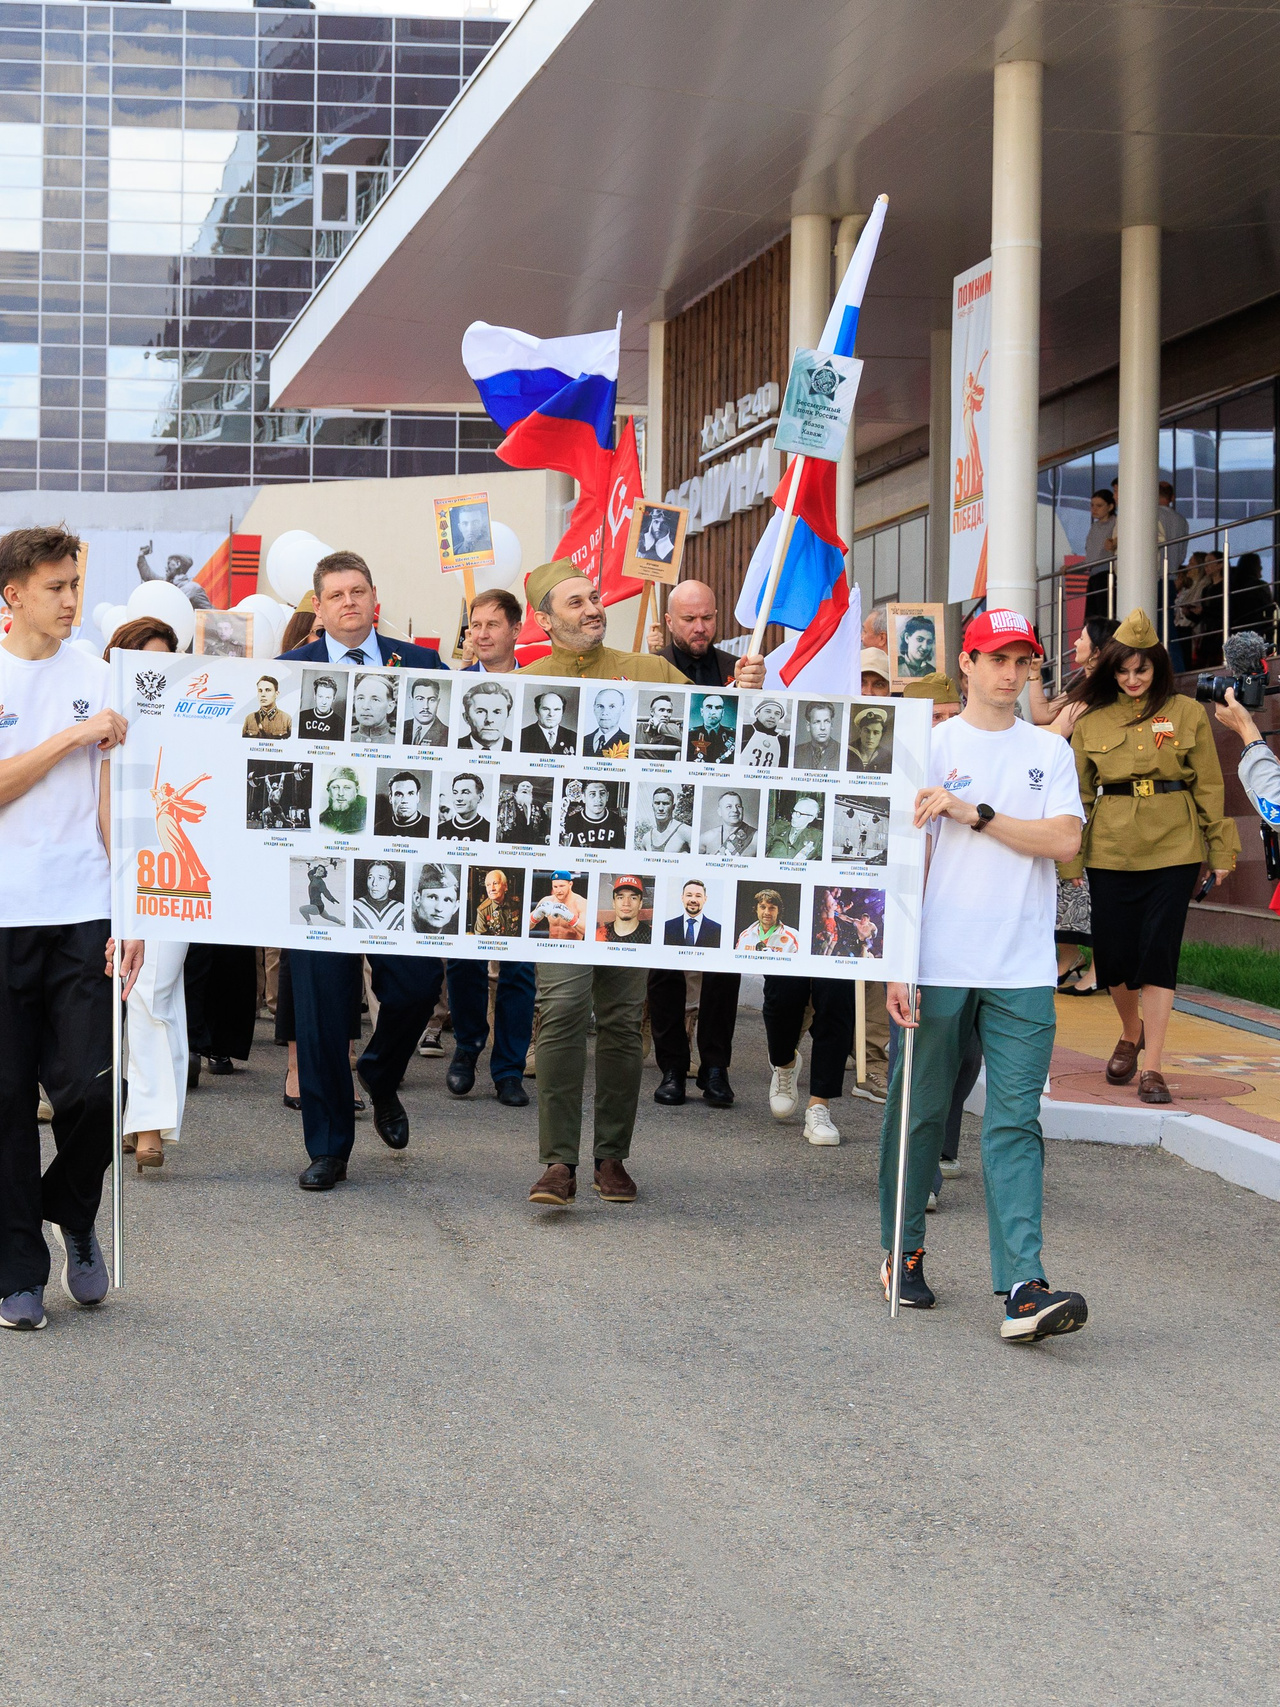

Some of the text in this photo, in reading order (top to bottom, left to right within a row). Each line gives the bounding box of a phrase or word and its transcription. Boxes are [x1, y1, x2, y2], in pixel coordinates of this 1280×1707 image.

[737, 382, 779, 428] 1240
[796, 399, 841, 414] Бессмертный
[797, 408, 838, 421] полк России
[803, 420, 825, 430] Абазов
[174, 701, 197, 714] ЮГ
[197, 702, 235, 717] Спорт
[305, 720, 331, 732] СССР
[749, 748, 774, 766] 38
[577, 828, 615, 844] СССР
[137, 849, 177, 890] 80
[136, 895, 212, 922] ПОБЕДА!
